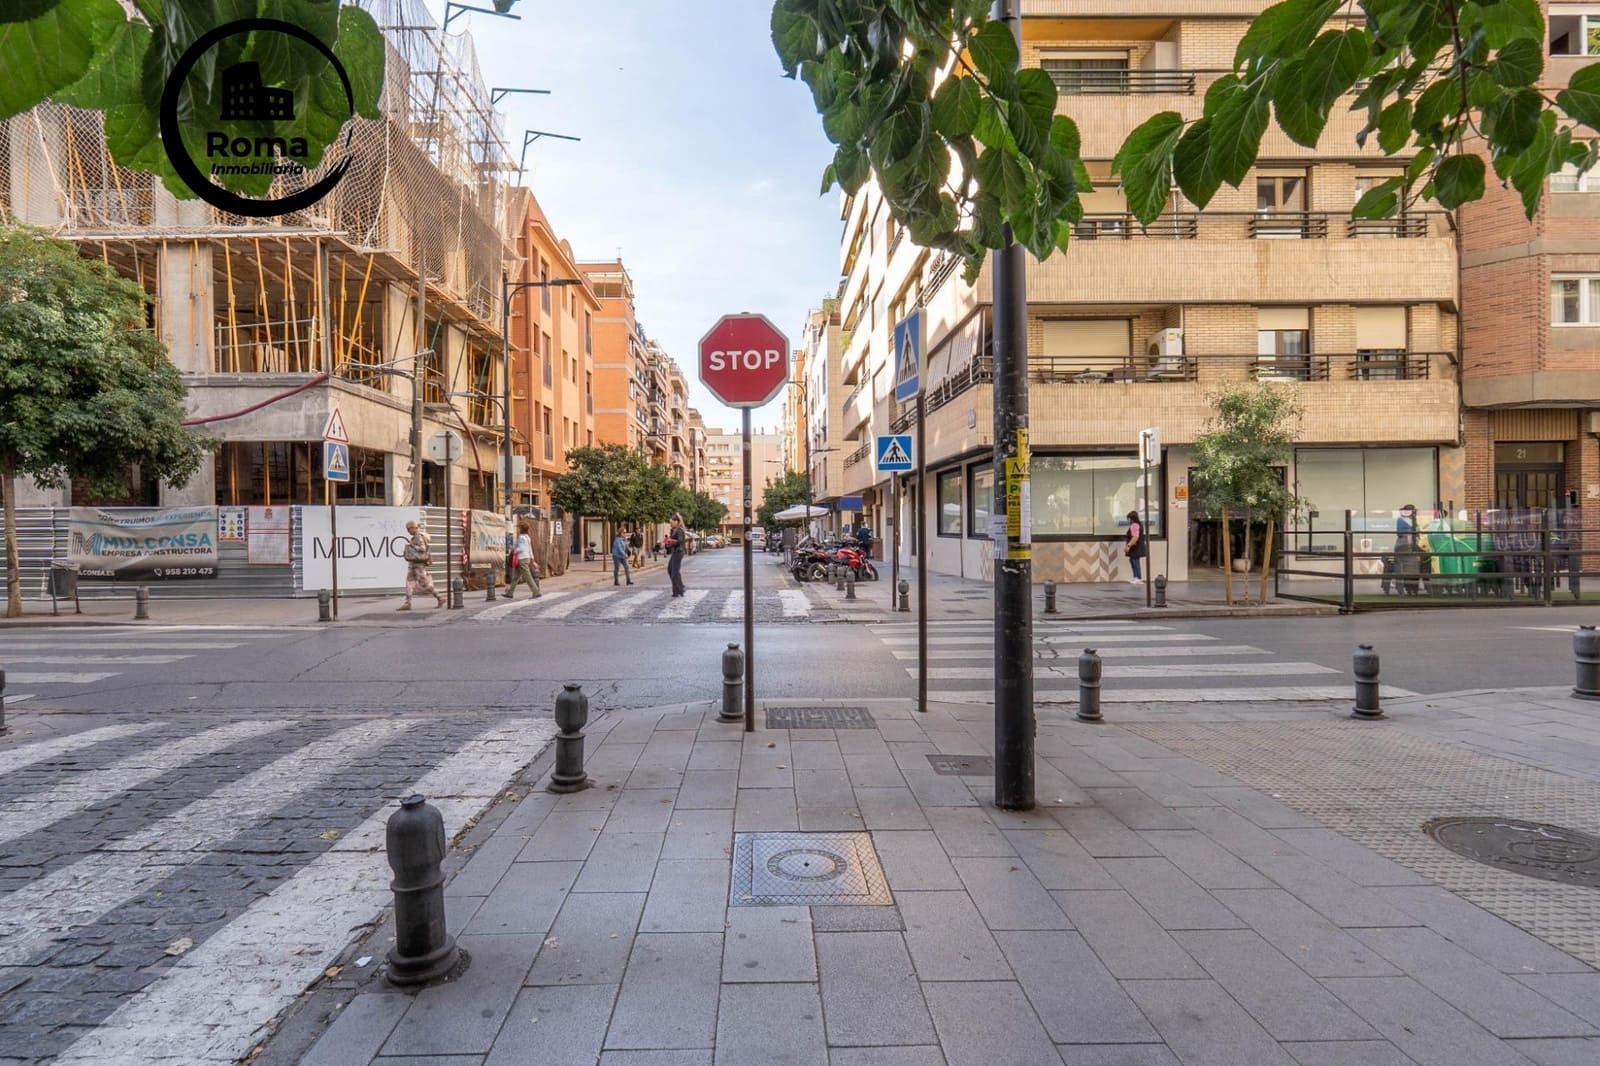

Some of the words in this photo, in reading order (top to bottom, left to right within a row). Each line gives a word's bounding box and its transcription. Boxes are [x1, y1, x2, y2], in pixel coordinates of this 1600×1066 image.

[709, 349, 780, 371] STOP
[1516, 448, 1526, 459] 21
[103, 533, 213, 549] MULCONSA
[102, 550, 142, 558] EMPRESA
[165, 568, 180, 576] 958
[182, 567, 196, 575] 210
[198, 567, 213, 575] 475
